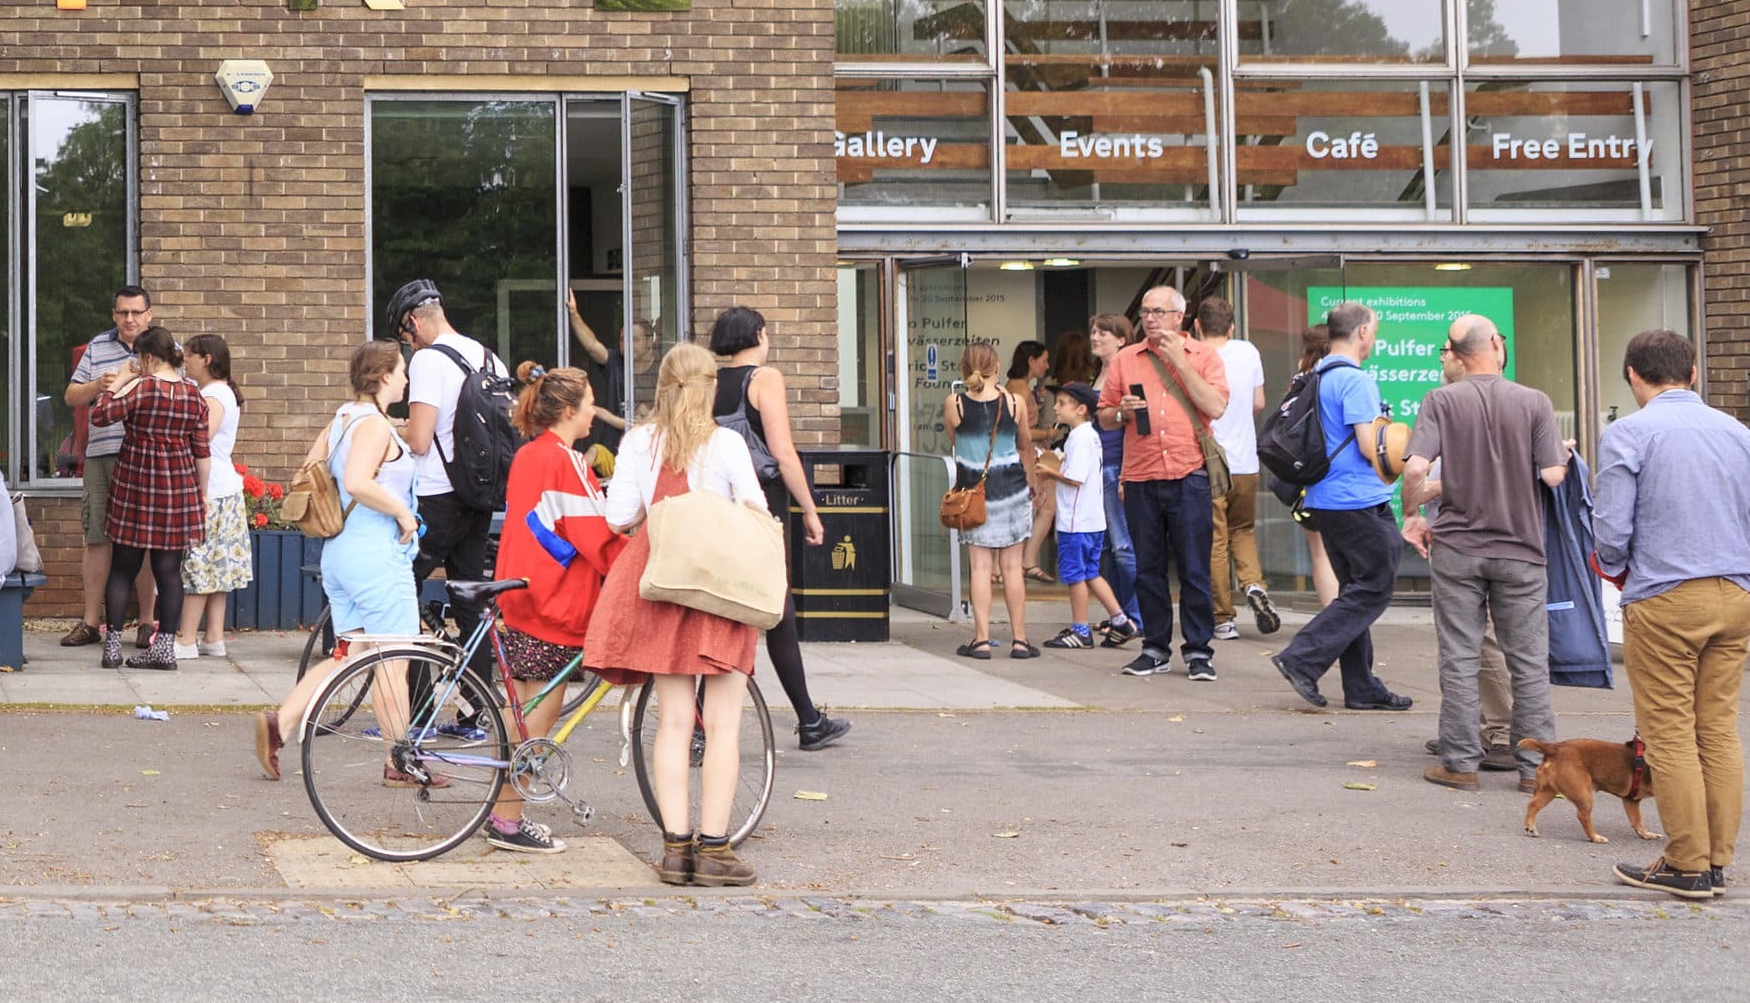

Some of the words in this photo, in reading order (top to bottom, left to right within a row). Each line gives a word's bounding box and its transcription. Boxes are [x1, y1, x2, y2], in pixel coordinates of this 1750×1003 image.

[834, 130, 937, 163] Gallery
[1060, 131, 1164, 159] Events
[1306, 131, 1379, 160] Café
[1493, 132, 1560, 160] Free
[1568, 132, 1653, 163] Entry
[1367, 296, 1427, 307] exhibitions
[923, 317, 966, 330] Pulfer
[1385, 310, 1445, 322] September
[1375, 339, 1436, 357] Pulfer
[1365, 365, 1444, 383] ässerze
[1400, 399, 1420, 417] St
[825, 494, 859, 506] Litter
